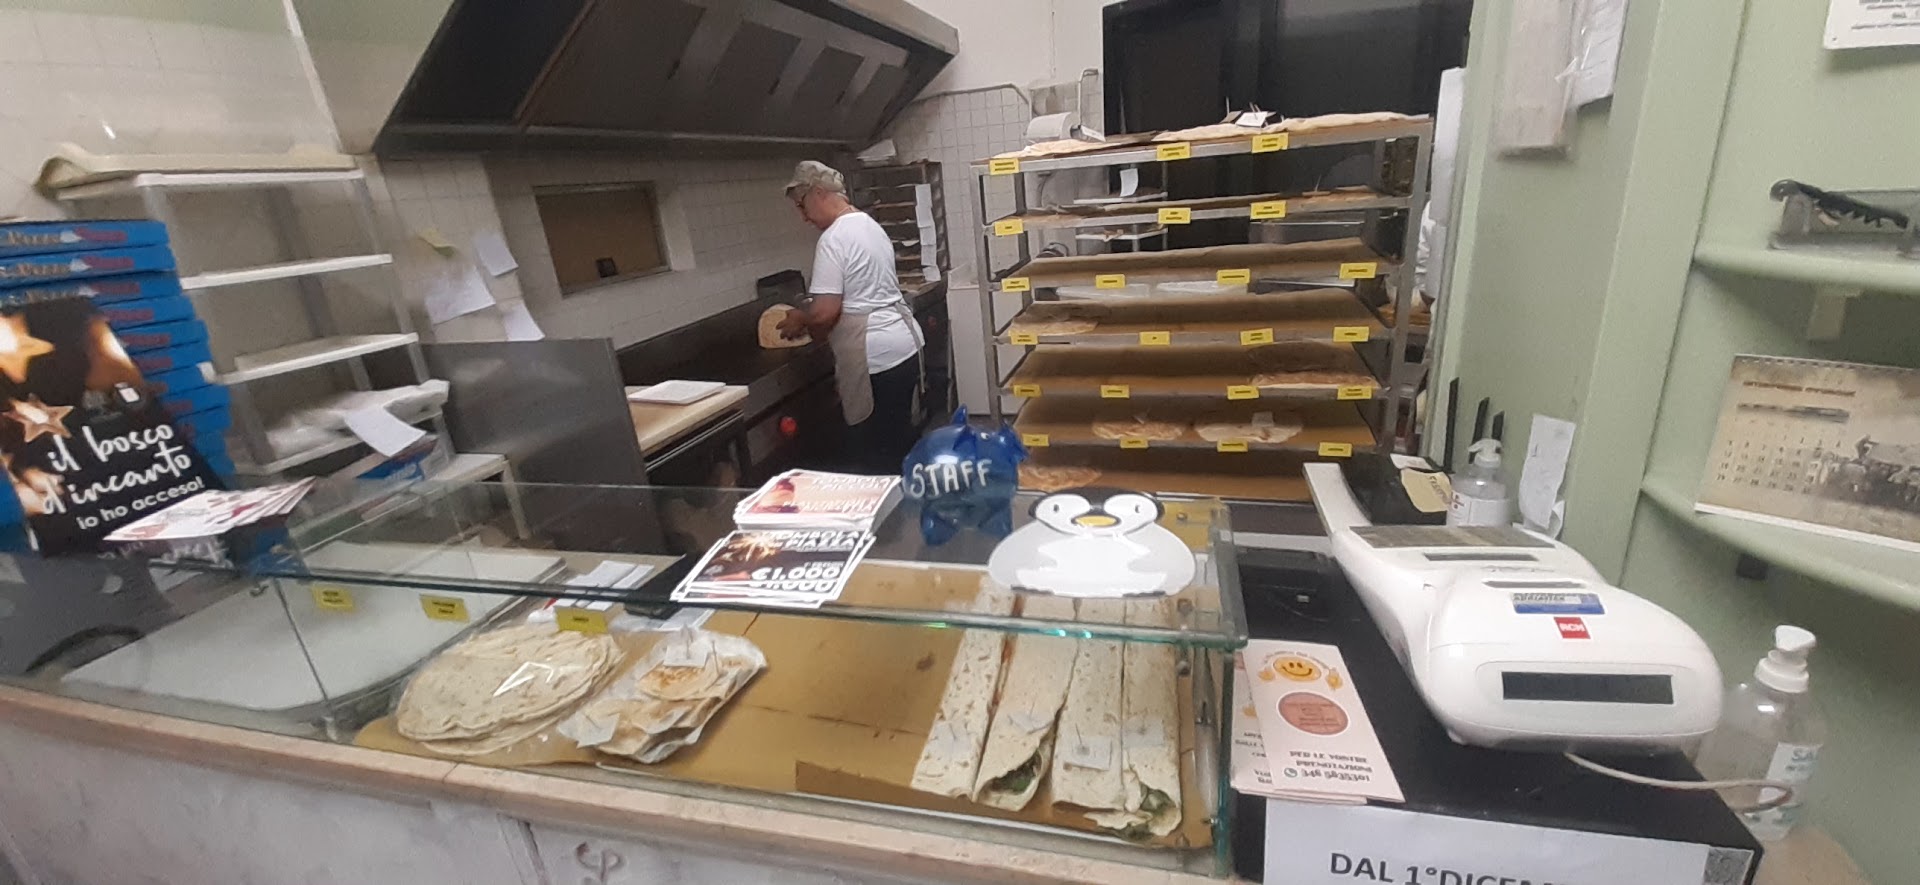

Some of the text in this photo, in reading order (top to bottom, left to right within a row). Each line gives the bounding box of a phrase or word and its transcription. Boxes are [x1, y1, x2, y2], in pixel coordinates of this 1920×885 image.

[47, 424, 174, 471] il bosco
[100, 504, 128, 522] ho
[132, 476, 206, 511] acceso!
[910, 459, 992, 499] STAFF
[1330, 852, 1394, 883] DAL
